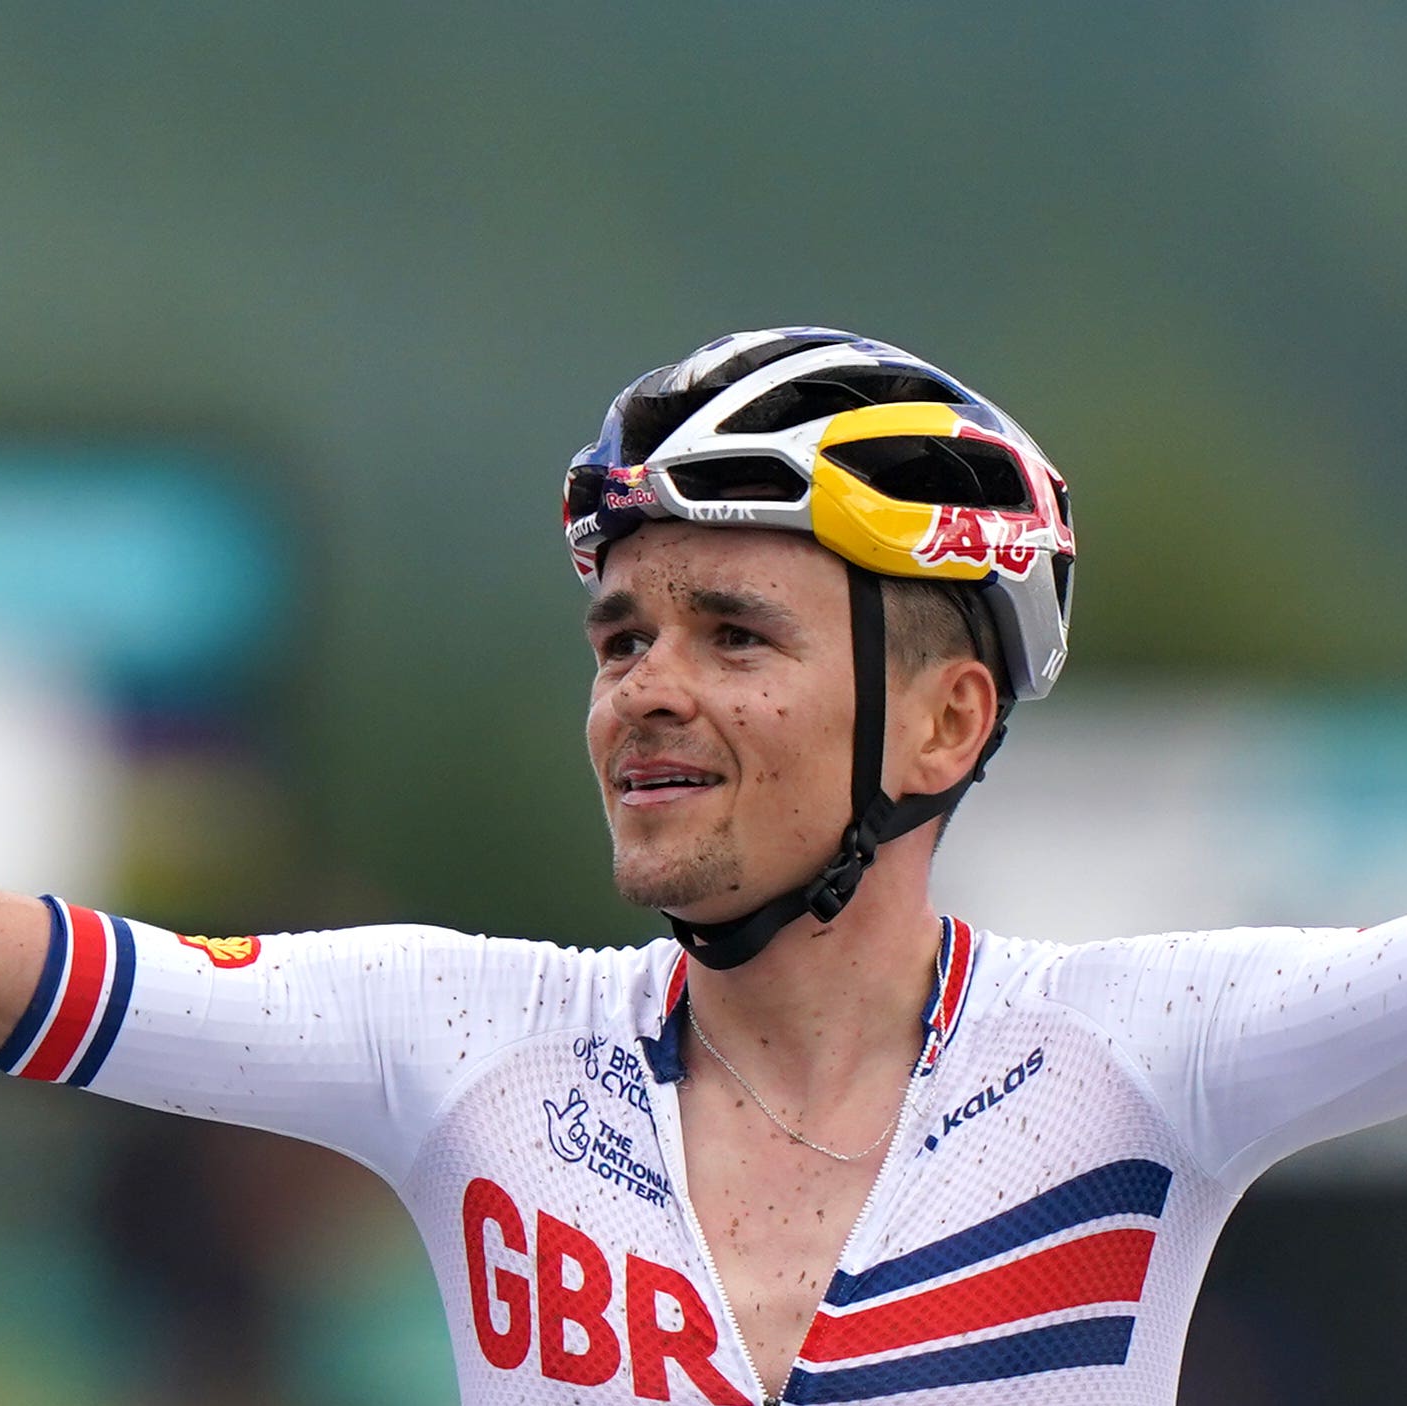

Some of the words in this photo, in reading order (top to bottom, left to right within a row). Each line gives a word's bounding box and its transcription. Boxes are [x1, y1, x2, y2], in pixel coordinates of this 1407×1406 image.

[606, 488, 635, 509] Red
[598, 1120, 633, 1154] THE
[587, 1154, 666, 1208] LOTTERY
[592, 1137, 673, 1196] NATIONAL
